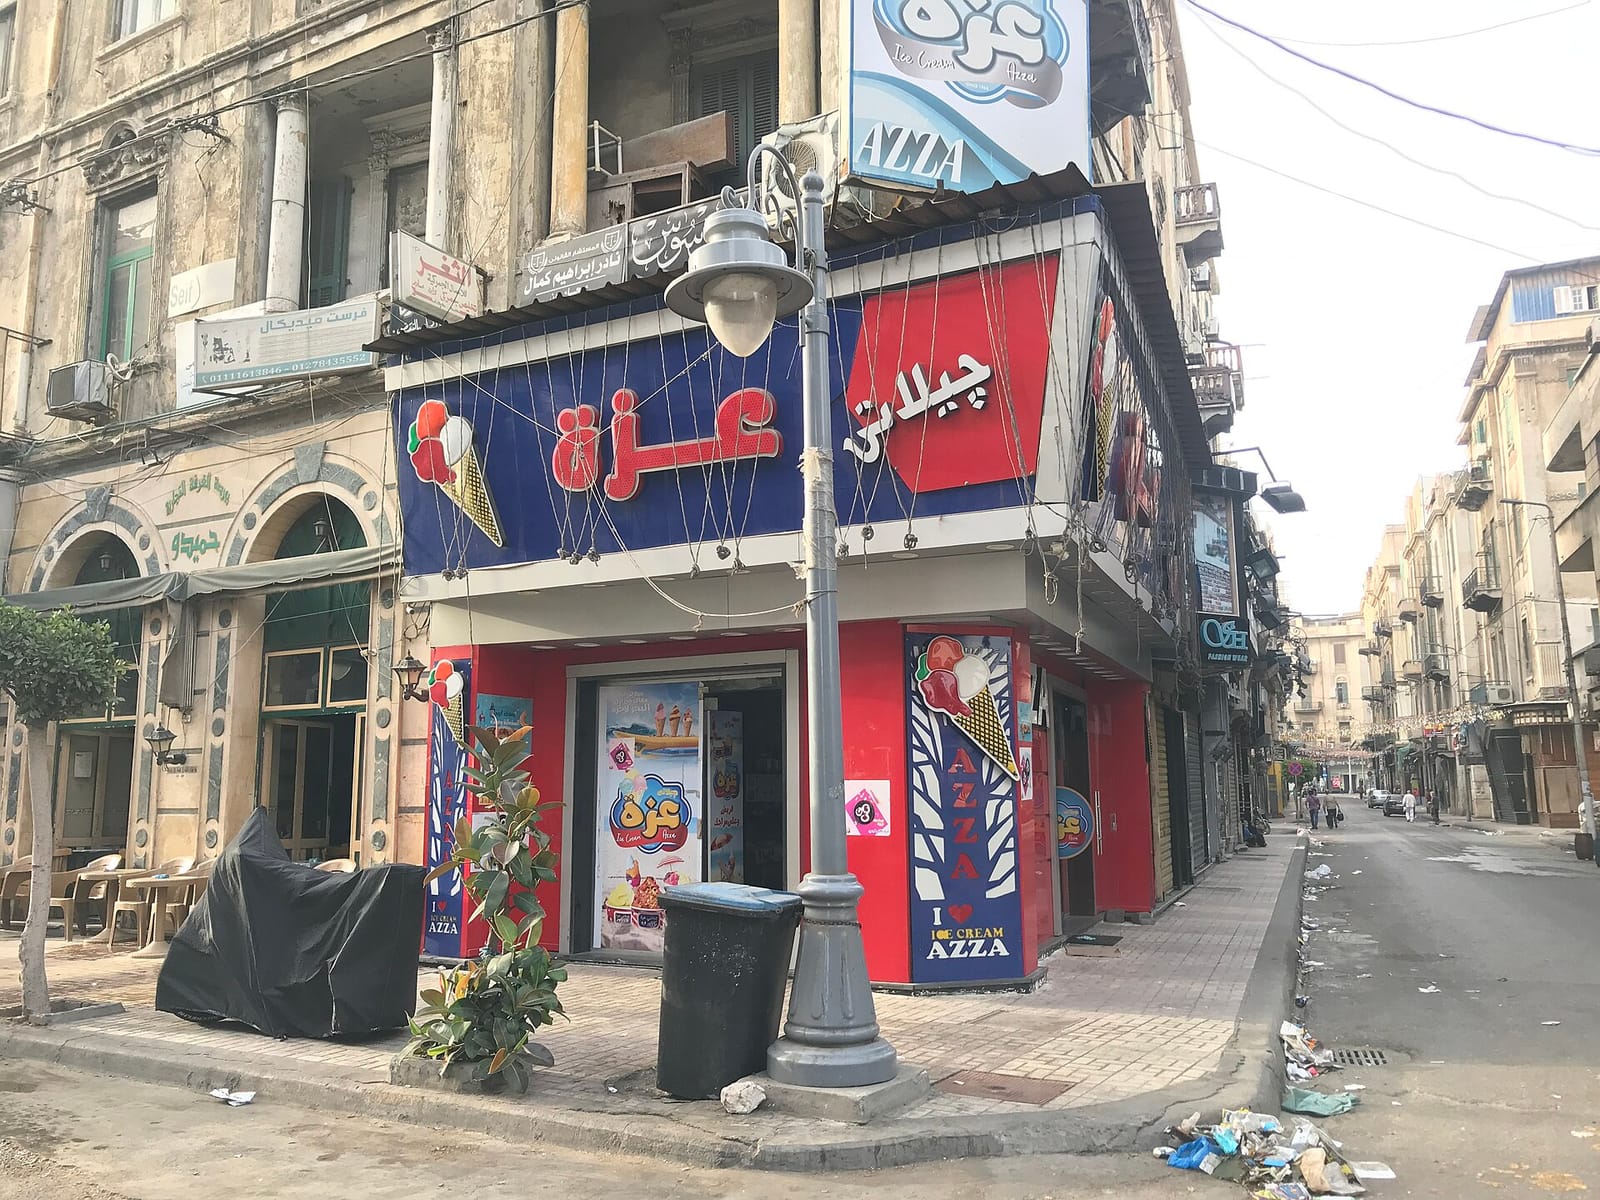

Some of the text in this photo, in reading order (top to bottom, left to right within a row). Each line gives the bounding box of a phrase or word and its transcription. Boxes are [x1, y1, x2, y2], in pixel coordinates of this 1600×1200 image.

[892, 43, 914, 64] Ice
[1006, 61, 1038, 84] Azza
[856, 121, 965, 184] AZZA
[594, 250, 621, 274] نادر
[523, 270, 553, 296] كمال
[260, 307, 368, 334] فرست ميديكال
[428, 921, 458, 935] AZZA
[932, 907, 943, 926] I
[956, 927, 1005, 940] CREAM
[926, 938, 1010, 960] AZZA
